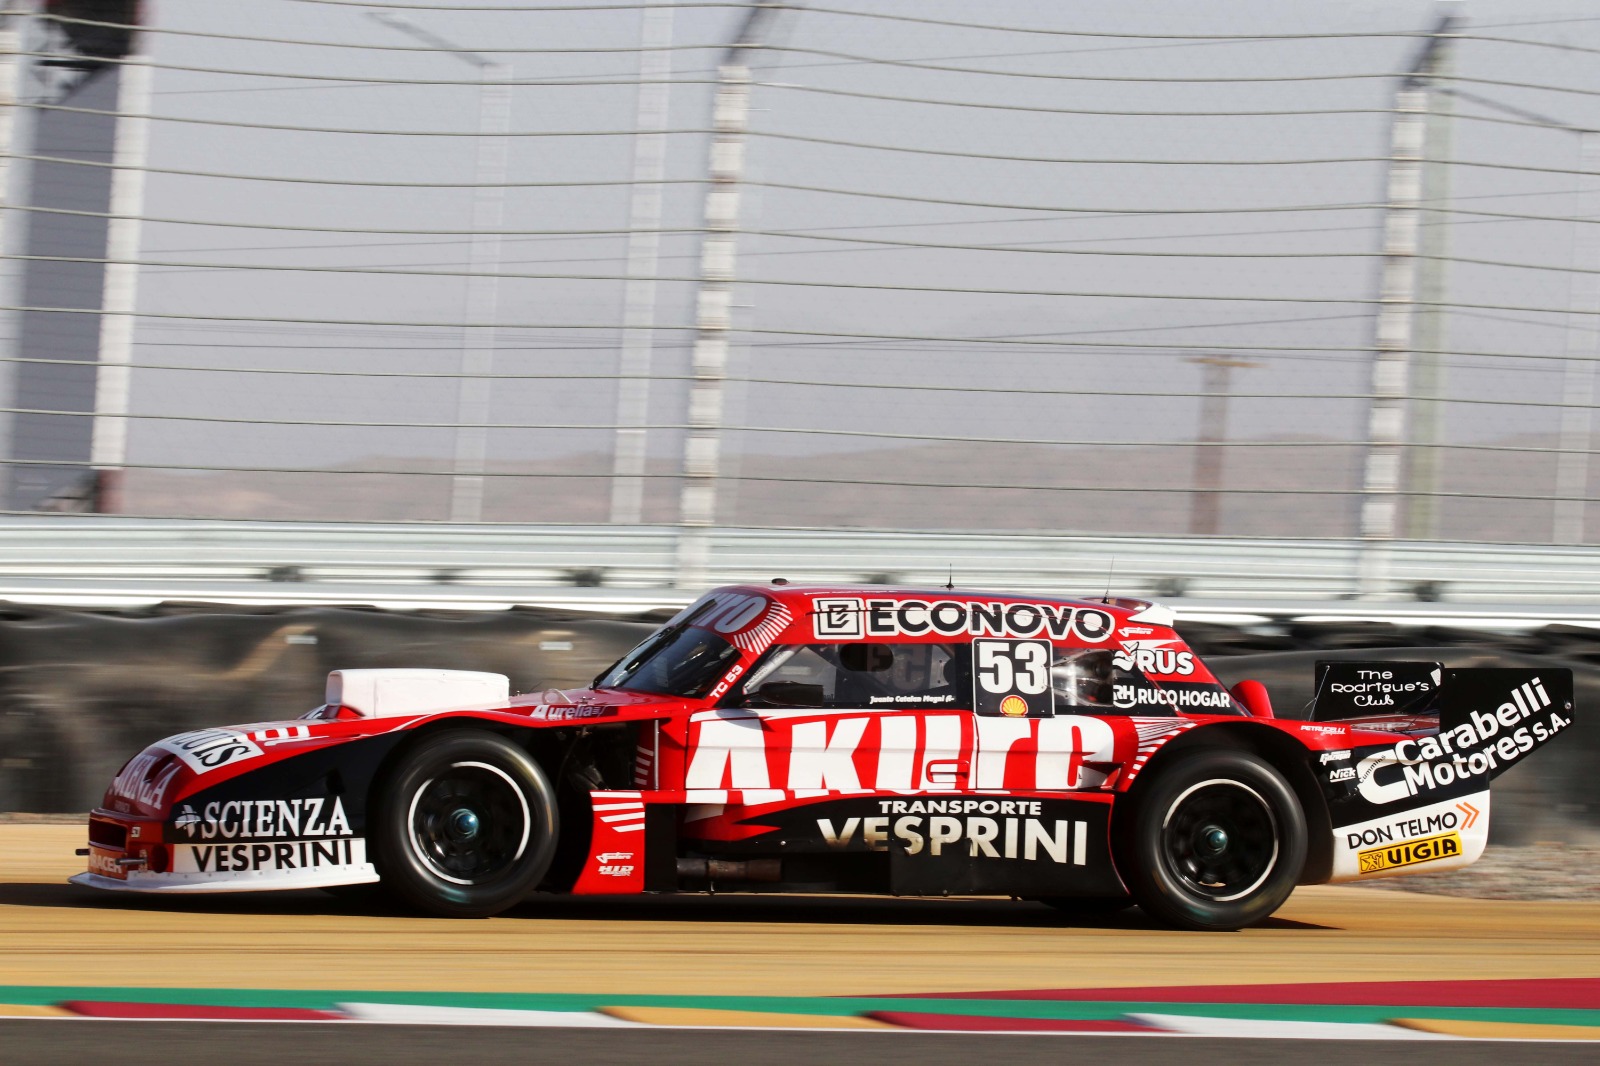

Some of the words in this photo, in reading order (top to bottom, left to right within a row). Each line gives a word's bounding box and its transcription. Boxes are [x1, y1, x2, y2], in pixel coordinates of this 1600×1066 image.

[868, 600, 1113, 641] ECONOVO
[977, 641, 1048, 695] 53
[1136, 649, 1195, 675] RUS
[1357, 670, 1393, 680] The
[709, 681, 728, 698] TC
[725, 664, 744, 683] 53
[1137, 688, 1178, 705] RUCO
[1179, 690, 1231, 708] HOGAR
[1331, 681, 1430, 693] Rodrigue's
[529, 704, 593, 720] Aurelia
[1353, 694, 1395, 707] Club
[1394, 676, 1552, 766] Carabelli
[1402, 727, 1534, 796] Motores
[1532, 714, 1572, 743] S.A.
[201, 796, 353, 839] SCIENZA
[879, 800, 1042, 816] TRANSPORTE
[816, 816, 1088, 866] VESPRINI
[1347, 825, 1394, 850] DON
[1395, 811, 1458, 839] TELMO
[191, 839, 353, 873] VESPRINI
